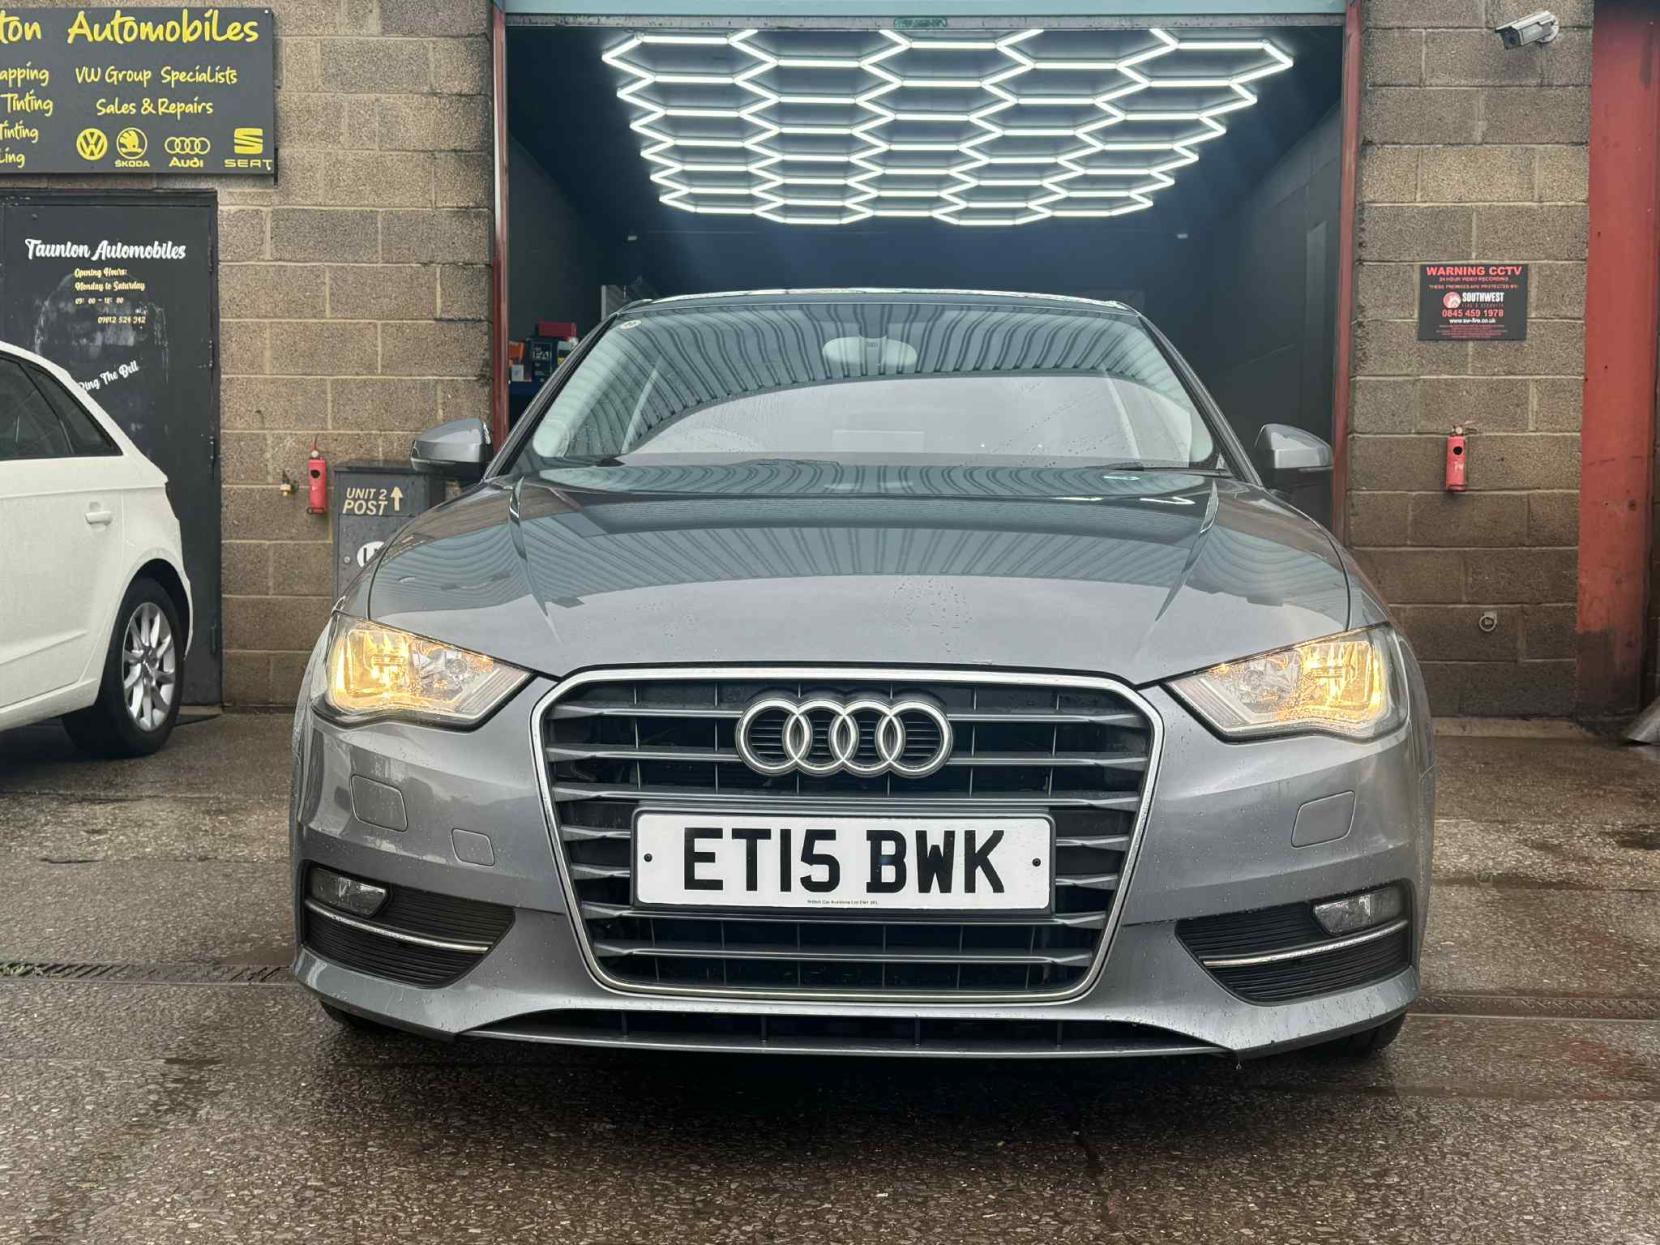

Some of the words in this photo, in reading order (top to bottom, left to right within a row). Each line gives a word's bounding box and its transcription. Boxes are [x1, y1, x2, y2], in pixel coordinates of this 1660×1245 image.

[67, 8, 259, 44] Automobiles
[75, 67, 101, 84] VW
[105, 67, 151, 88] Group
[160, 64, 238, 88] Specialists
[0, 89, 54, 117] Tinting
[96, 97, 137, 116] Sales
[140, 98, 156, 116] &
[157, 96, 214, 121] Repairs
[168, 156, 204, 168] Audi
[224, 159, 273, 169] SEAT
[25, 238, 90, 260] Taunton
[91, 240, 187, 261] Automobiles
[1426, 266, 1486, 276] WARNING
[1488, 266, 1522, 276] CCTV
[1462, 292, 1504, 302] SOUTHWEST
[1465, 309, 1481, 317] 459
[1484, 309, 1504, 317] 1978
[100, 370, 118, 385] The
[346, 488, 376, 499] UNIT
[379, 489, 387, 500] 2
[342, 499, 388, 515] POST
[684, 827, 841, 893] ET15
[866, 829, 1005, 894] BWK
